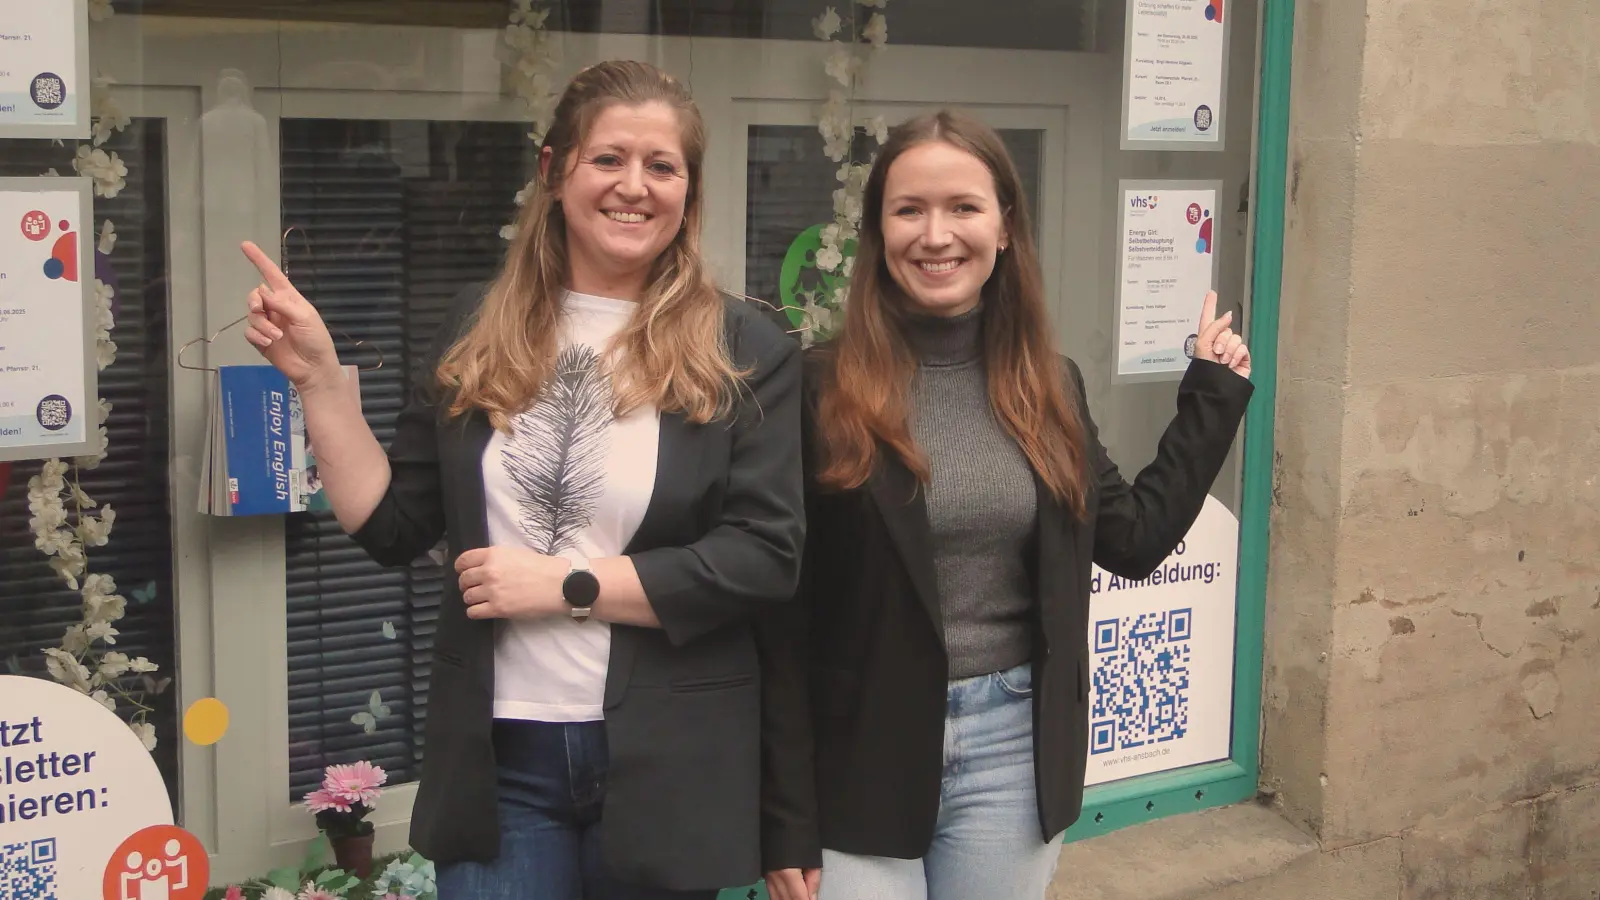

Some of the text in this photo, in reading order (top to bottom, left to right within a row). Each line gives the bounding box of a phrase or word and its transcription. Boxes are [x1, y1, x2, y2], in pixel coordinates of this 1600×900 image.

[0, 104, 15, 112] en!
[1130, 195, 1148, 208] vhs
[1128, 229, 1146, 237] Energy
[288, 387, 302, 420] et's
[269, 390, 289, 501] Enjoy English
[0, 716, 43, 748] tzt
[0, 751, 97, 786] letter
[1102, 747, 1171, 768] www.vhs-ansbach.de
